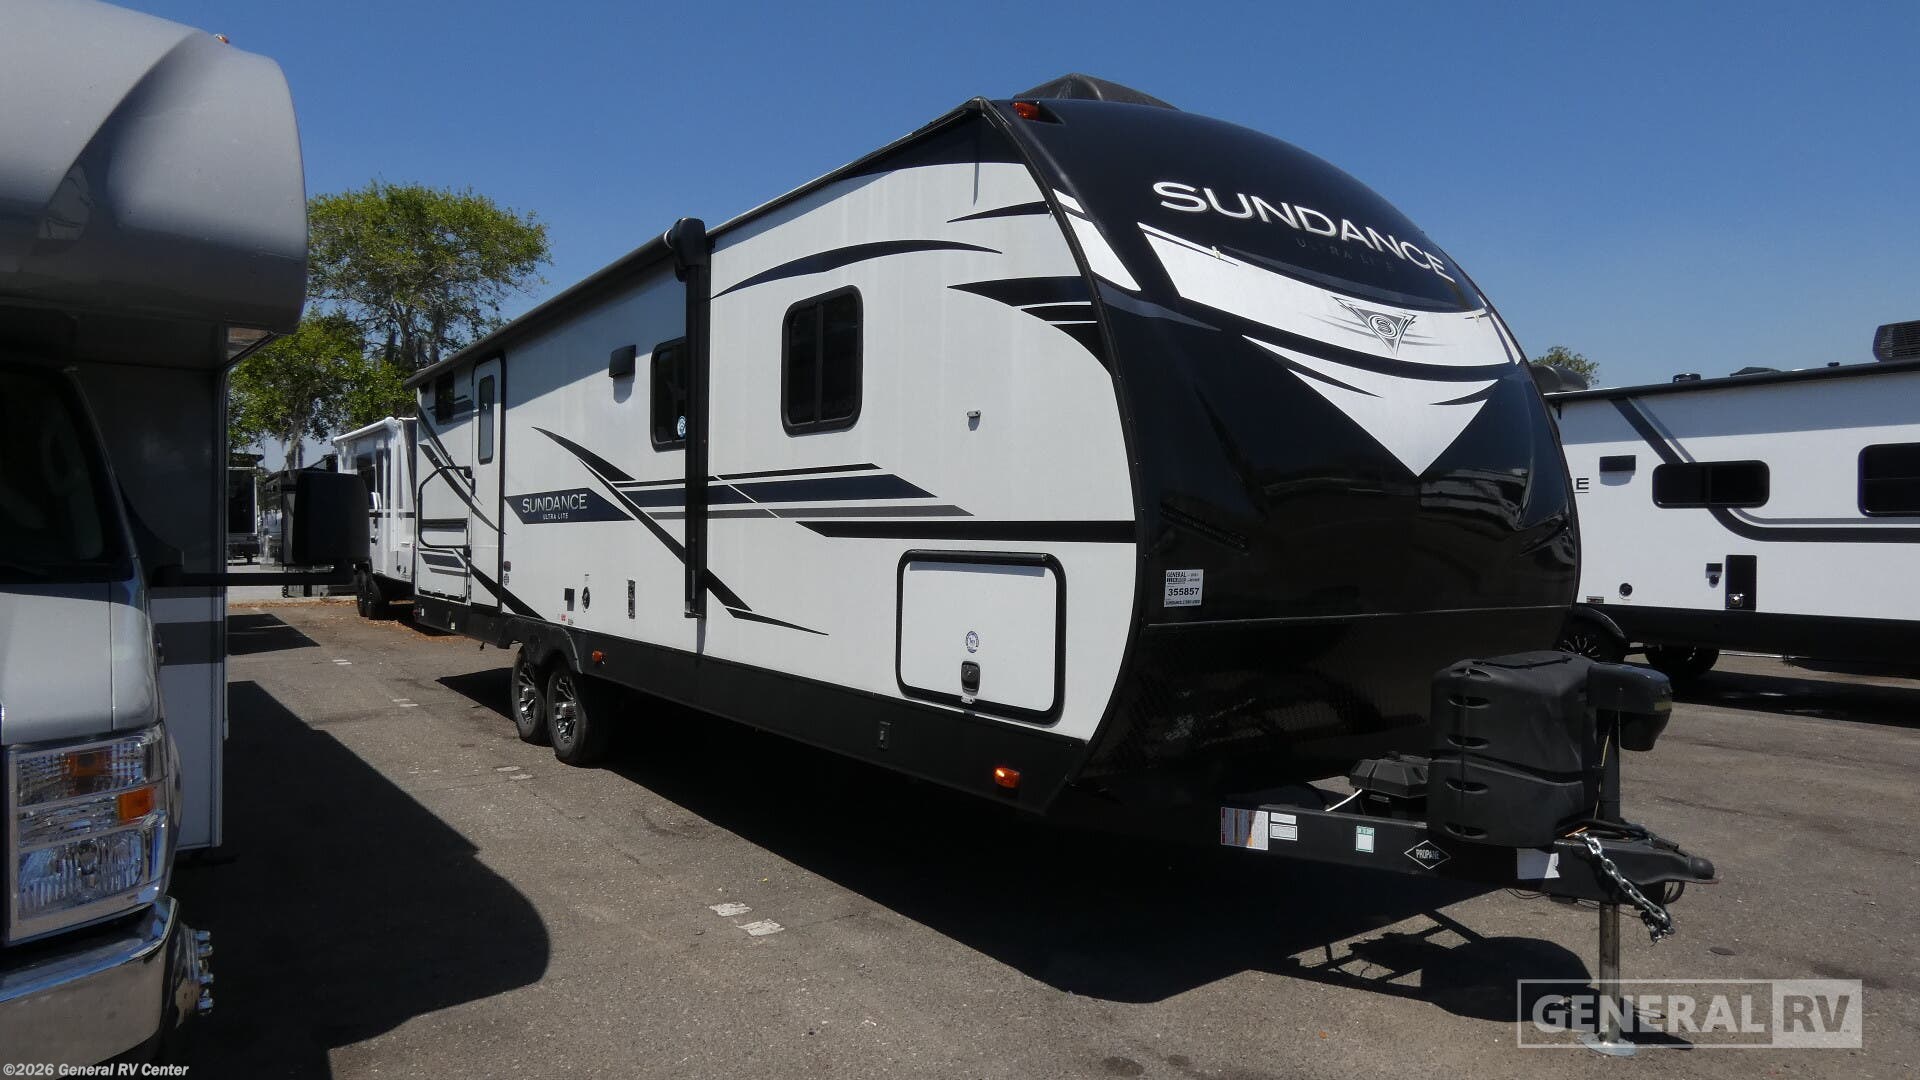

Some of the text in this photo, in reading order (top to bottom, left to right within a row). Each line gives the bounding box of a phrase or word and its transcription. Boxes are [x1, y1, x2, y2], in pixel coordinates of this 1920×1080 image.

[1153, 181, 1456, 284] SUNDANCE
[522, 494, 587, 513] SUNDANCE
[1168, 587, 1199, 596] 355857
[1415, 848, 1441, 860] PROPANE
